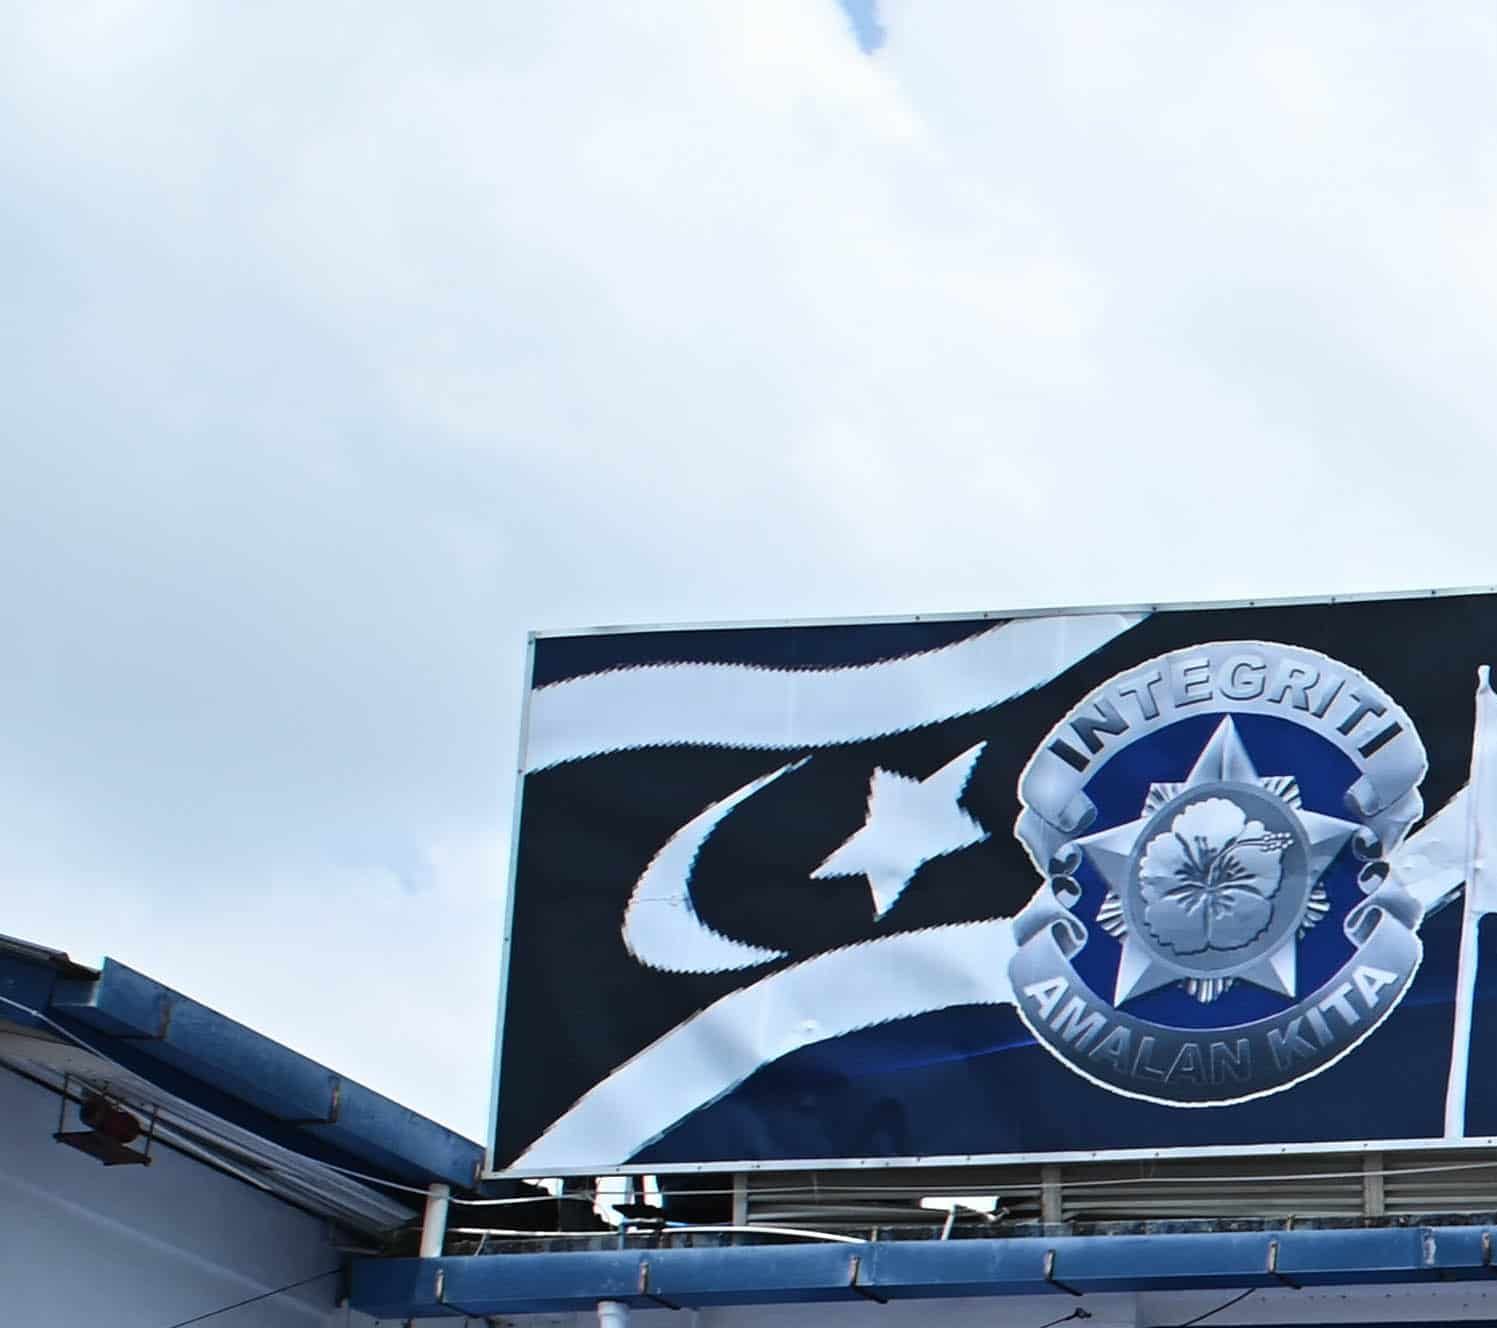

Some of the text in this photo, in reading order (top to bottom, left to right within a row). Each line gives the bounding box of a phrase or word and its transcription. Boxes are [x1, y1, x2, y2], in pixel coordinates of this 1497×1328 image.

[1047, 654, 1404, 774] INTEGRITI
[1022, 964, 1399, 1086] AMALAN KITA
